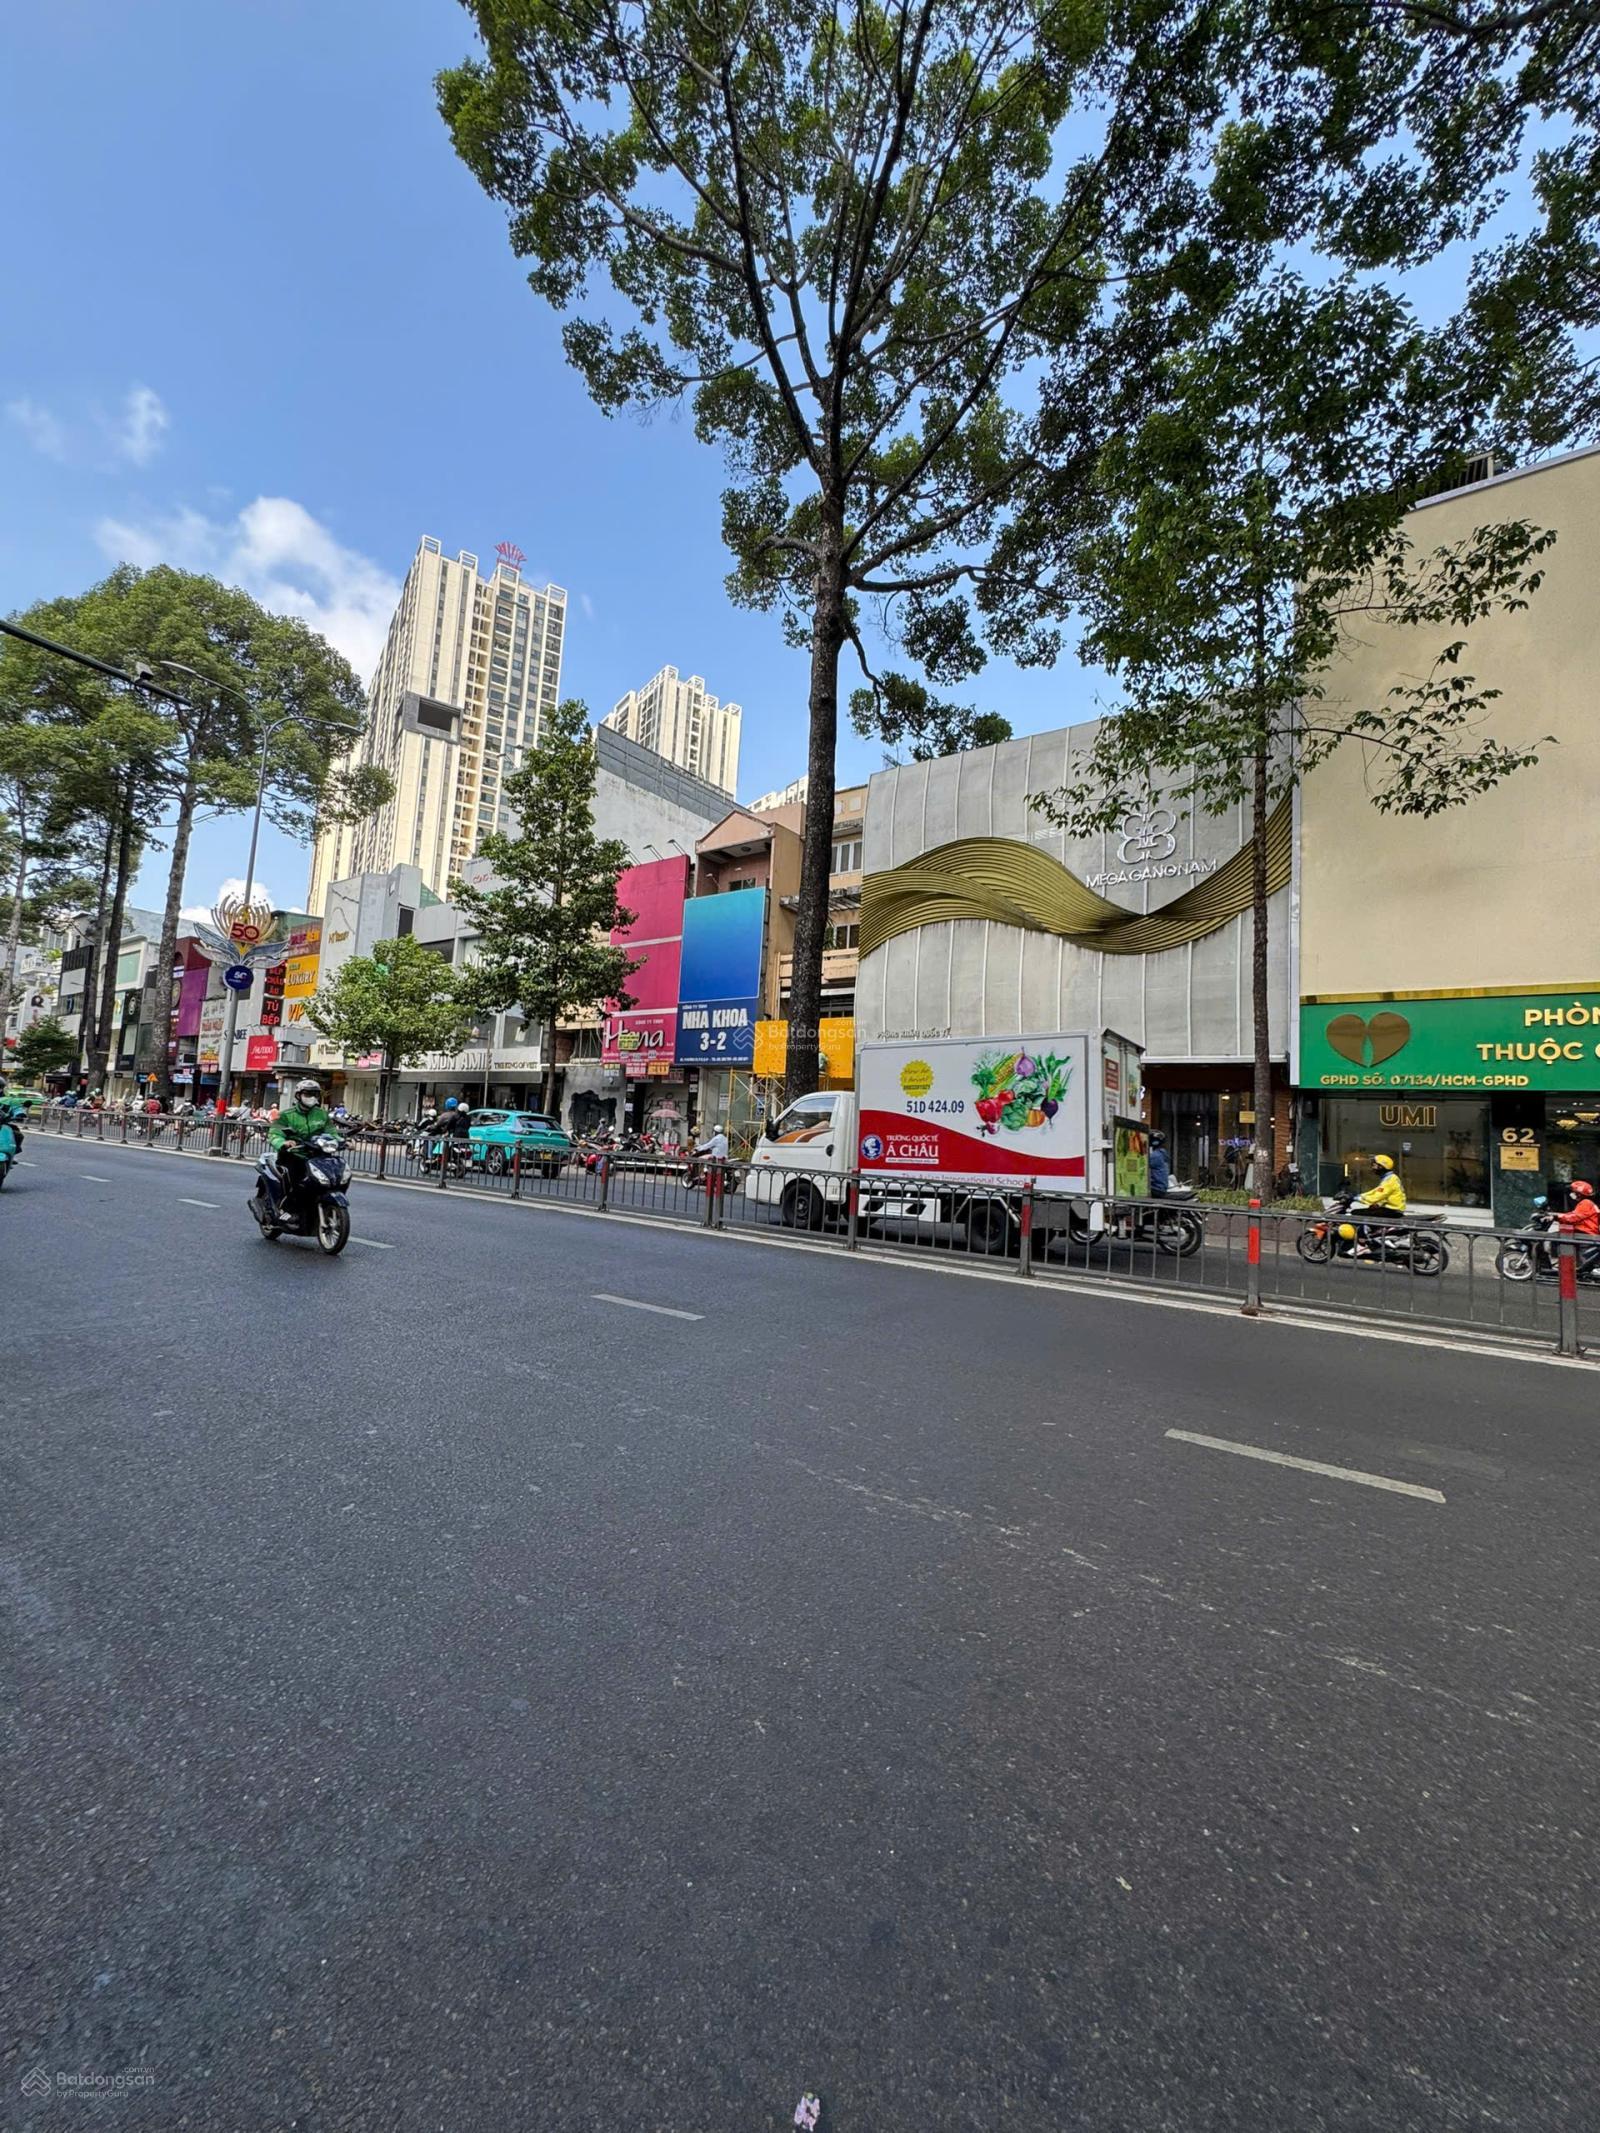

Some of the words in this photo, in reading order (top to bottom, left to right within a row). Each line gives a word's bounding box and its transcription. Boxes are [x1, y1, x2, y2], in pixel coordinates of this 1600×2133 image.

[231, 922, 260, 942] 50
[682, 1010, 709, 1029] NHA
[712, 1008, 748, 1028] KHOA
[700, 1031, 727, 1051] 3-2
[1476, 1037, 1584, 1065] THUỘC
[1320, 1075, 1359, 1086] GPHD
[906, 1101, 926, 1114] 51D
[928, 1100, 965, 1113] 424.09
[1379, 1105, 1437, 1127] UMI
[1502, 1127, 1535, 1143] 62
[899, 1142, 939, 1157] CHÂU
